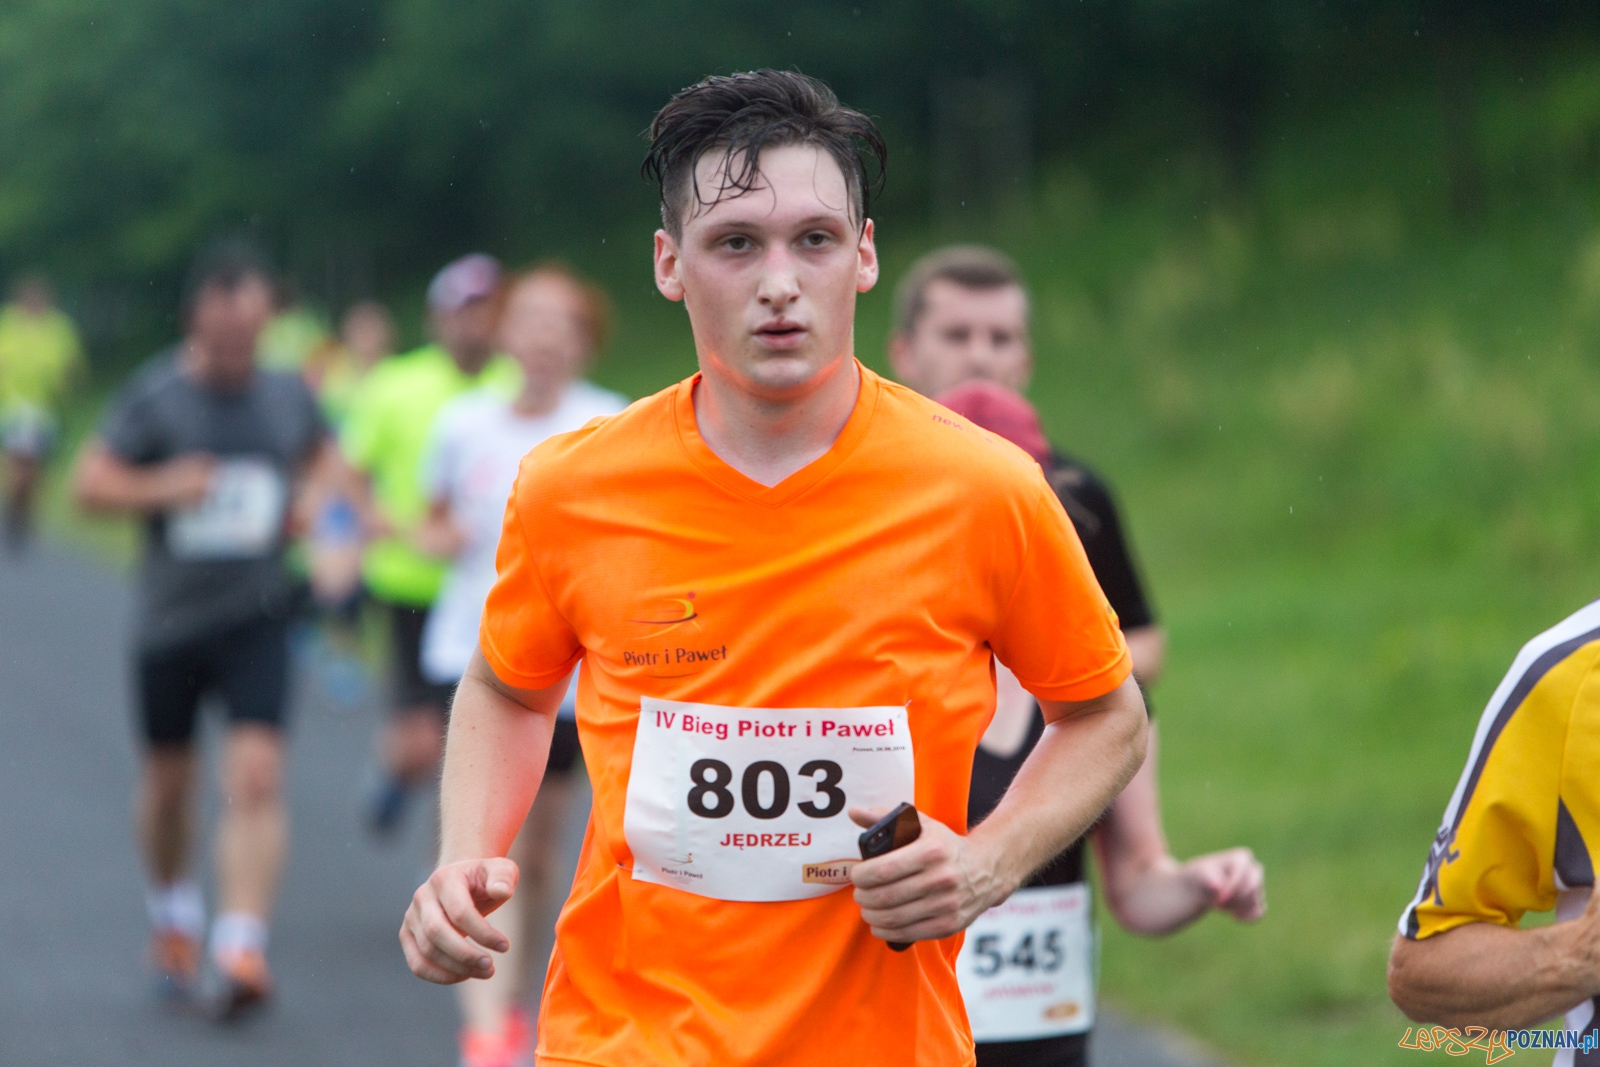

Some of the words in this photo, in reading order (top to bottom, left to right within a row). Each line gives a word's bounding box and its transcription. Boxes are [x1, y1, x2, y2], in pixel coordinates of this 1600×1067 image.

[931, 414, 963, 431] new
[623, 650, 659, 666] Piotr
[664, 648, 670, 665] i
[655, 711, 676, 729] IV
[681, 714, 728, 740] Bieg
[737, 720, 797, 738] Piotr
[805, 720, 812, 737] i
[821, 718, 895, 738] Paweł
[687, 758, 846, 820] 803
[719, 833, 812, 850] JĘDRZEJ
[806, 866, 840, 878] Piotr
[843, 866, 848, 876] i
[972, 929, 1064, 977] 545
